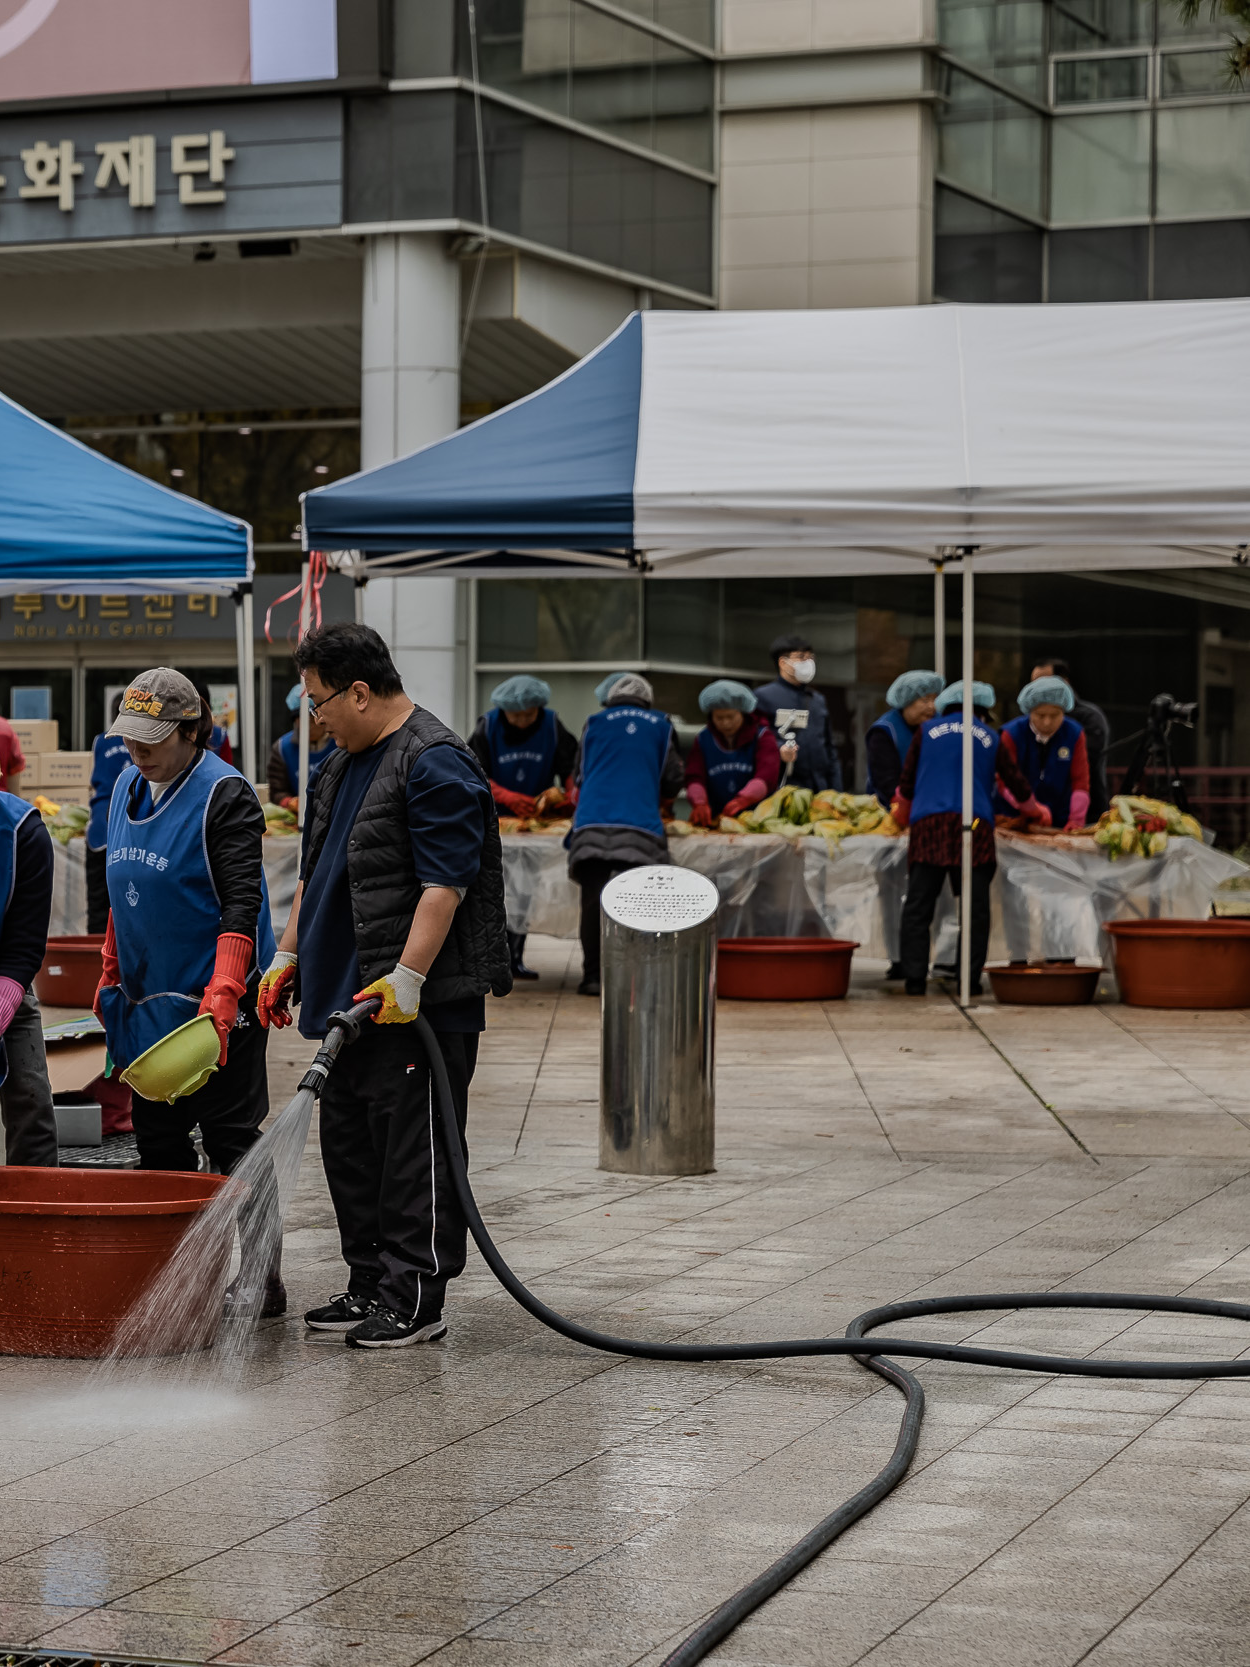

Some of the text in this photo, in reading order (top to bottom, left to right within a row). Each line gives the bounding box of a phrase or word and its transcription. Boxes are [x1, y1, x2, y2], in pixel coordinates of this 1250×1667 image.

[13, 620, 174, 638] Naru Arts Center
[124, 698, 163, 718] GLOVE
